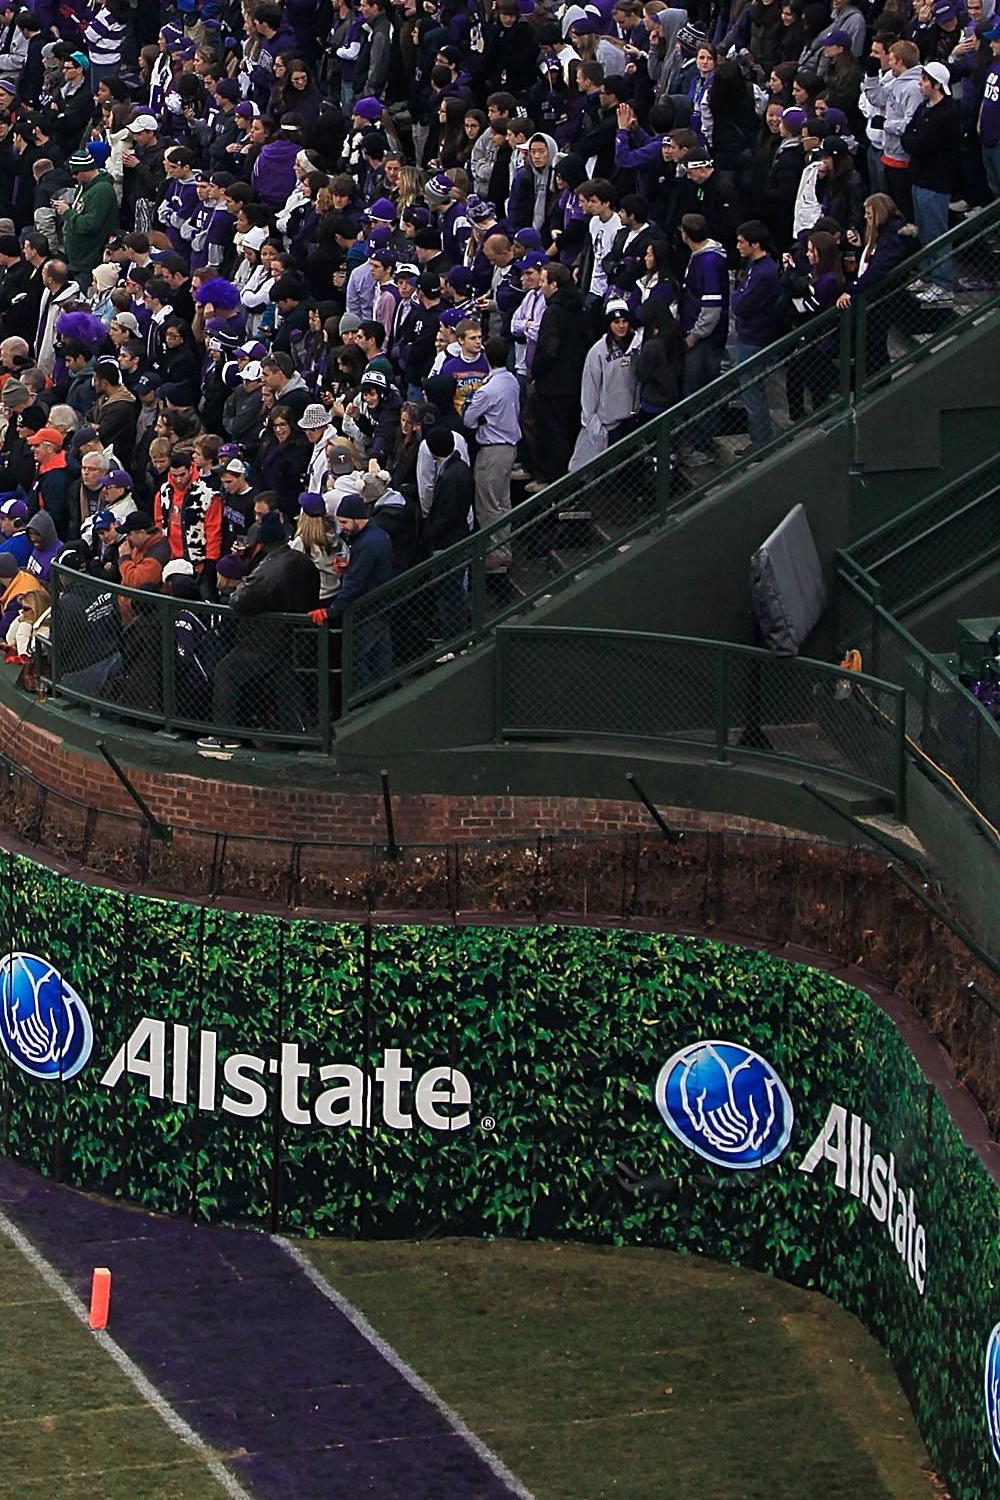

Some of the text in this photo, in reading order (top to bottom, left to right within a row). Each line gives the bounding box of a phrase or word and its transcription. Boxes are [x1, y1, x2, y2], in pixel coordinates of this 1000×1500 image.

[986, 72, 999, 85] GO
[100, 1017, 472, 1132] Allstate
[798, 1102, 928, 1296] Allstate
